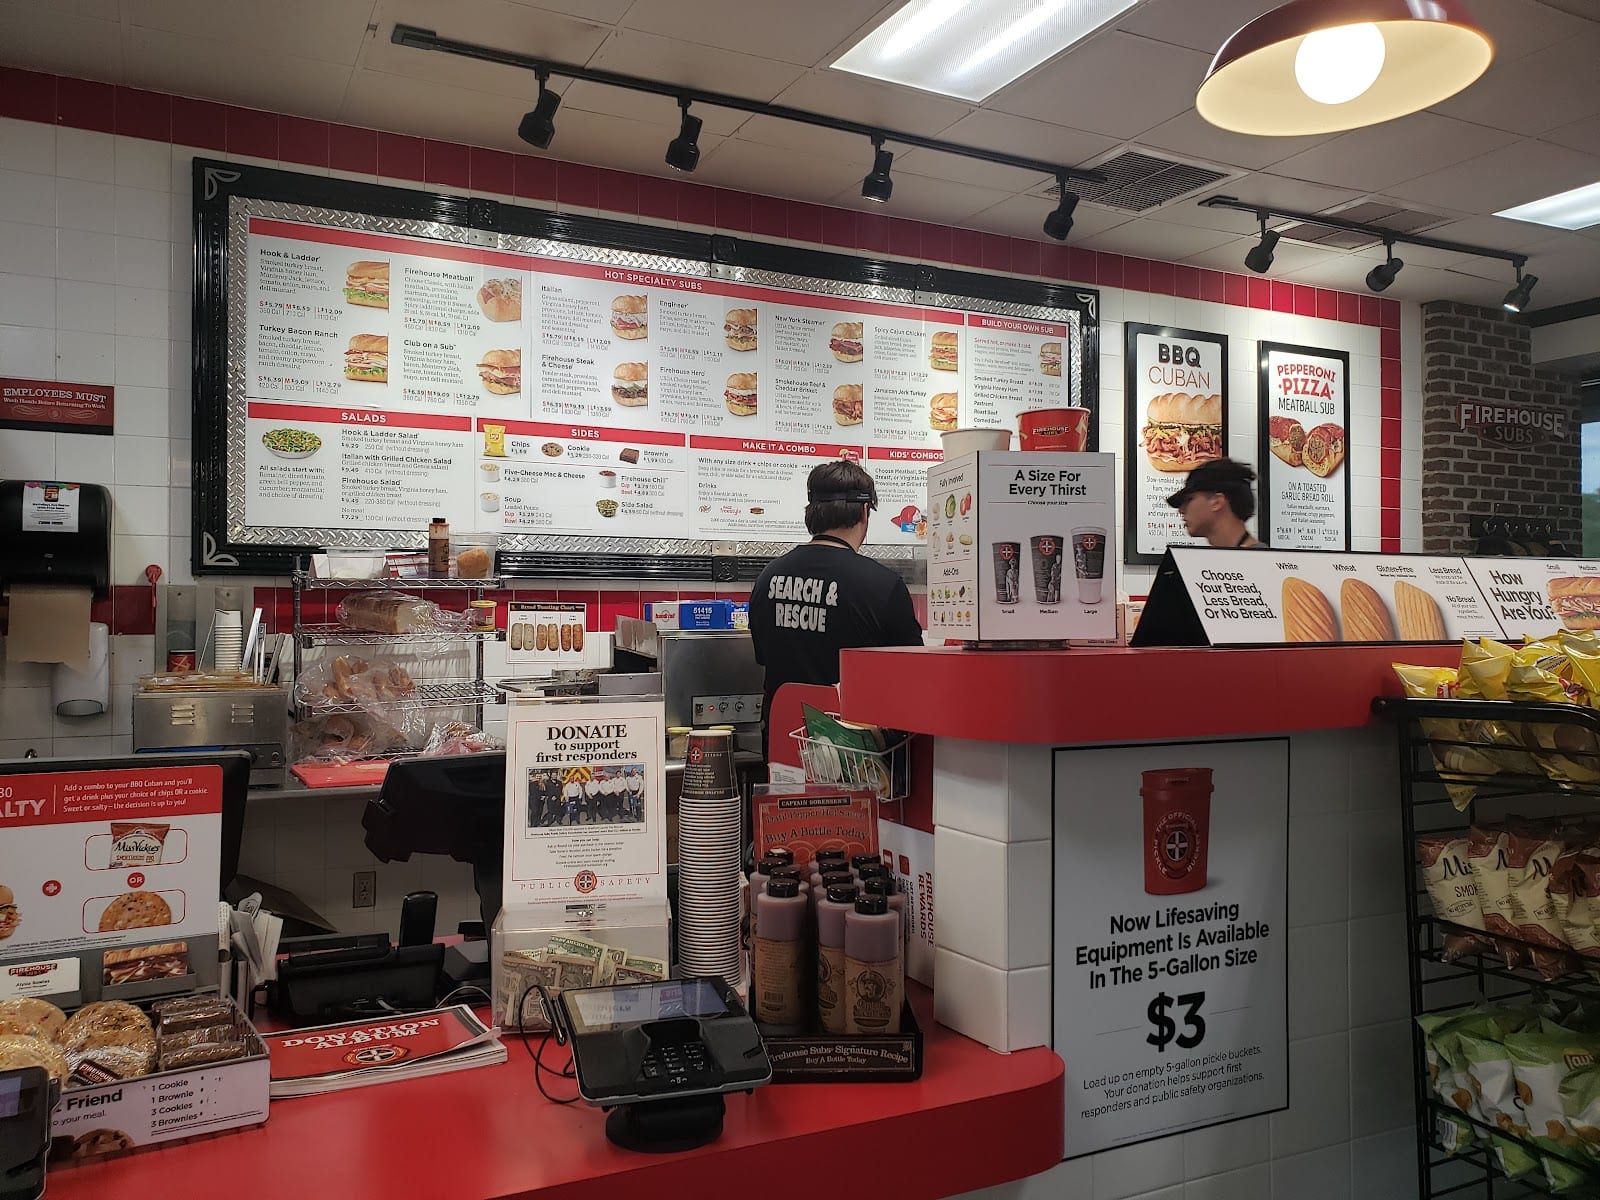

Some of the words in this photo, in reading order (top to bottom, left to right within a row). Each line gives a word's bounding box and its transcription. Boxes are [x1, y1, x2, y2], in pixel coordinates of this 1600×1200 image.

[260, 249, 282, 258] Hook
[404, 268, 440, 277] Firehouse
[442, 273, 472, 282] Meatball
[604, 270, 624, 280] HOT
[627, 273, 676, 287] SPECIALTY
[679, 280, 702, 290] SUBS
[541, 285, 563, 294] Italian
[259, 324, 286, 334] Turkey
[314, 330, 338, 338] Ranch
[1003, 321, 1022, 329] YOUR
[1022, 323, 1040, 331] OWN
[542, 354, 574, 363] Firehouse
[1159, 343, 1202, 368] BBQ
[1149, 366, 1210, 389] CUBAN
[1277, 364, 1336, 383] PEPPERONI
[3, 388, 72, 399] EMPLOYEES
[76, 392, 106, 403] MUST
[1282, 378, 1331, 400] PIZZA
[1279, 397, 1318, 413] MEATBALL
[1320, 402, 1335, 414] SUB
[342, 412, 387, 423] SALADS
[1460, 403, 1565, 438] FIREHOUSE
[571, 429, 600, 438] SIDES
[1495, 426, 1533, 443] SUBS
[742, 442, 766, 450] MAKE
[786, 444, 816, 453] COMBO
[911, 451, 944, 460] COMBOS
[504, 468, 543, 477] Five-Cheese
[1015, 470, 1025, 481] A
[1028, 470, 1056, 482] Size
[1059, 470, 1081, 482] For
[1009, 484, 1046, 497] Every
[1049, 484, 1086, 496] Thirst
[1288, 482, 1297, 491] ON
[1298, 482, 1302, 491] A
[1302, 482, 1326, 492] TOASTED
[1282, 491, 1301, 500] GARLIC
[1302, 492, 1319, 501] BREAD
[943, 567, 959, 577] Add-Ons
[1276, 562, 1299, 570] White
[1332, 564, 1357, 572] Wheat
[1201, 570, 1245, 581] Choose
[1489, 570, 1523, 585] How
[768, 576, 824, 604] SEARCH
[826, 581, 838, 606] &
[1195, 582, 1222, 593] Your
[1223, 583, 1262, 595] Bread,
[1202, 595, 1230, 606] Less
[1230, 596, 1268, 608] Bread,
[1490, 587, 1543, 605] Hungry
[776, 602, 826, 632] RESCUE
[1204, 608, 1219, 619] Or
[1221, 608, 1239, 619] No
[1239, 608, 1277, 619] Bread.
[1501, 605, 1526, 620] Are
[1521, 605, 1557, 620] You?
[546, 724, 627, 740] DONATE
[554, 742, 566, 751] to
[570, 740, 620, 752] support
[536, 752, 563, 762] first
[566, 750, 637, 763] responders
[64, 795, 75, 803] get
[101, 793, 113, 801] plus
[115, 792, 128, 800] your
[766, 832, 787, 843] Buy
[790, 828, 798, 838] A
[801, 826, 832, 837] Bottle
[115, 841, 135, 852] Miss
[1154, 840, 1167, 874] PICKLE
[520, 881, 570, 890] PUBLIC
[600, 877, 651, 887] SAFETY
[918, 874, 926, 939] REWARDS
[926, 872, 935, 948] FIREHOUSE
[1110, 915, 1151, 934] Now
[1156, 902, 1239, 928] Lifesaving
[1076, 934, 1173, 966] Equipment
[1178, 932, 1191, 950] Is
[1196, 920, 1270, 947] Available
[10, 963, 57, 975] FIREHOUSE
[1090, 970, 1106, 989] In
[1110, 965, 1142, 985] The
[1148, 954, 1220, 980] 5-Gallon
[1224, 948, 1257, 967] Size
[1146, 991, 1206, 1052] $3
[281, 1019, 439, 1047] DONATION
[314, 1028, 419, 1050] ALBUM
[847, 1056, 866, 1064] Today
[1083, 1074, 1106, 1090] Load
[1108, 1075, 1120, 1087] up
[1122, 1072, 1134, 1082] on
[1136, 1065, 1165, 1080] empty
[1166, 1058, 1200, 1074] 5-gallon
[1202, 1051, 1227, 1066] pickle
[1229, 1045, 1263, 1059] buckets.
[158, 1079, 188, 1091] Cookie
[1104, 1087, 1124, 1100] Your
[1126, 1079, 1166, 1095] donation
[1167, 1073, 1190, 1088] helps
[1192, 1068, 1225, 1083] support
[1226, 1062, 1242, 1073] first
[67, 1089, 123, 1110] Friend
[158, 1090, 194, 1103] Brownie
[1081, 1101, 1132, 1119] responders
[1134, 1095, 1150, 1107] and
[1152, 1090, 1178, 1105] public
[1180, 1084, 1206, 1099] safety
[1208, 1072, 1265, 1091] organizations.
[158, 1102, 193, 1114] Cookies
[158, 1113, 198, 1127] Brownies
